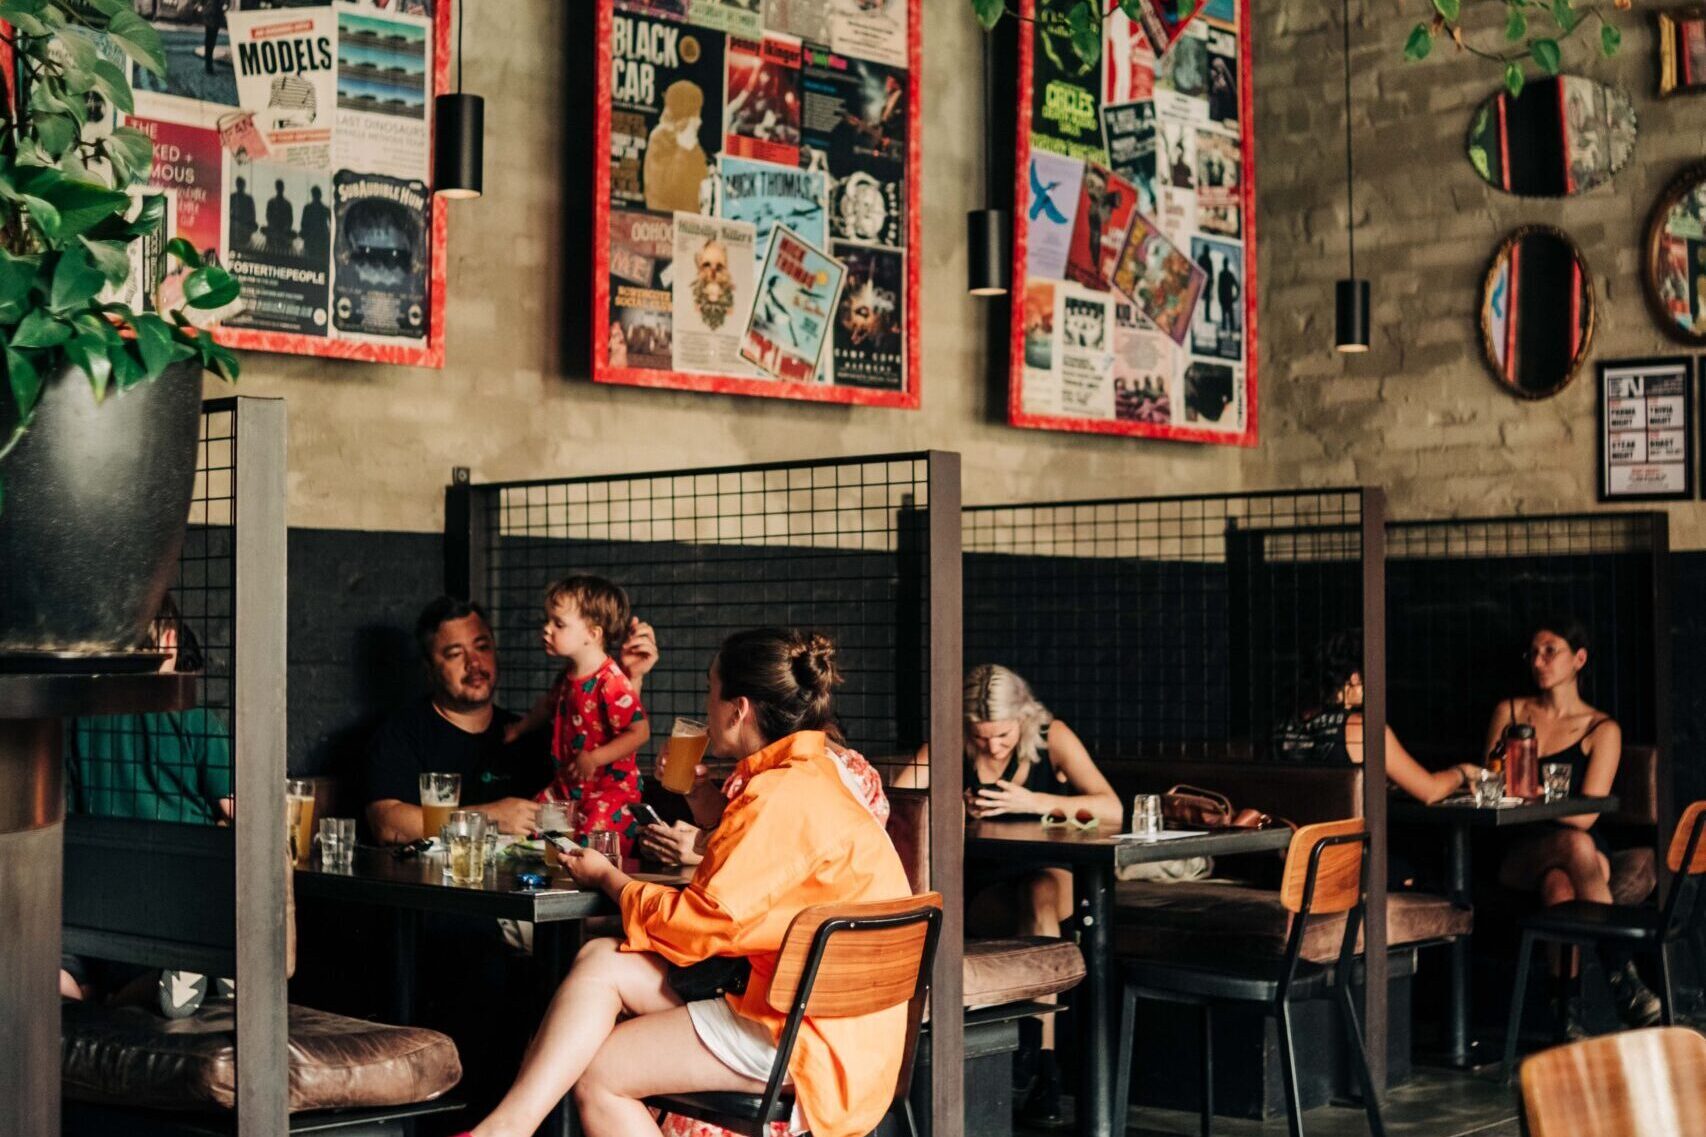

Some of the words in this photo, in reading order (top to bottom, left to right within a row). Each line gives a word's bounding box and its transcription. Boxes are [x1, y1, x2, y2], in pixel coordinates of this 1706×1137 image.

[238, 37, 332, 76] MODELS
[613, 16, 679, 68] BLACK
[612, 57, 656, 104] CAB
[131, 120, 158, 140] THE
[152, 143, 181, 163] KED
[151, 165, 195, 184] MOUS
